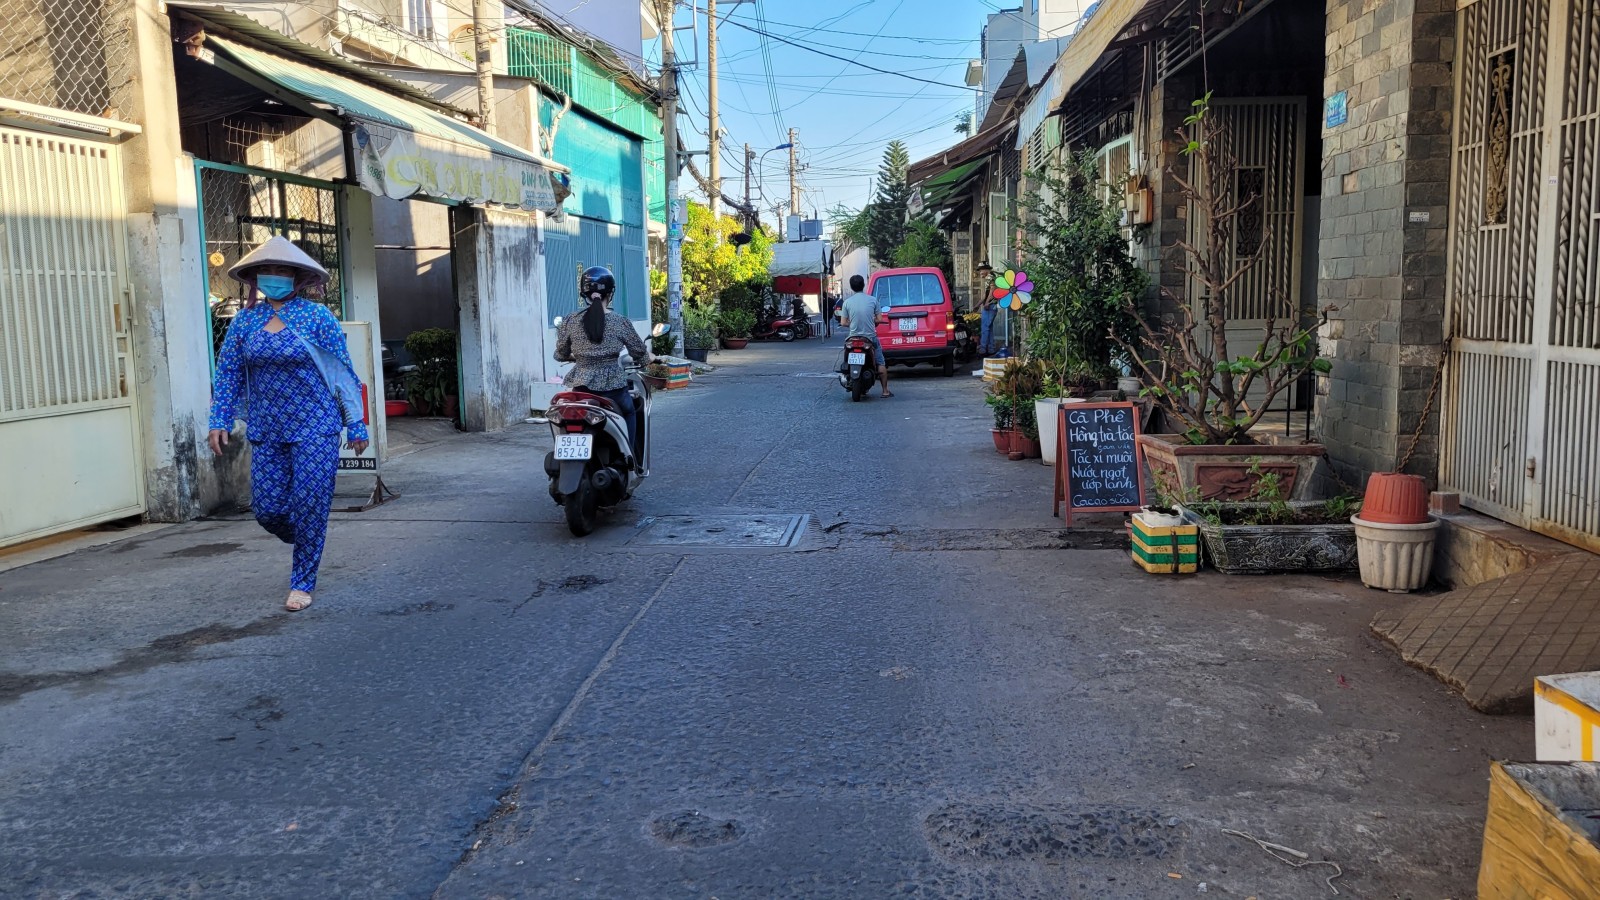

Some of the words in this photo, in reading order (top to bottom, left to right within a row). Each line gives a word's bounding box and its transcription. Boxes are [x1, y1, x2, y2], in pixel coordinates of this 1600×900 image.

[1094, 409, 1126, 423] Phê
[561, 436, 587, 446] 59-L2
[1070, 426, 1098, 447] Hồng
[1098, 425, 1117, 442] trà
[1116, 425, 1135, 441] tắc
[557, 448, 589, 458] 852.48
[1070, 449, 1092, 464] Tắc
[346, 460, 359, 468] 239
[362, 460, 374, 468] 184
[1071, 464, 1100, 478] Nước
[1100, 464, 1128, 480] ngọt
[1104, 476, 1136, 492] lạnh
[1072, 494, 1108, 507] Cacao
[1109, 492, 1134, 504] sữa
